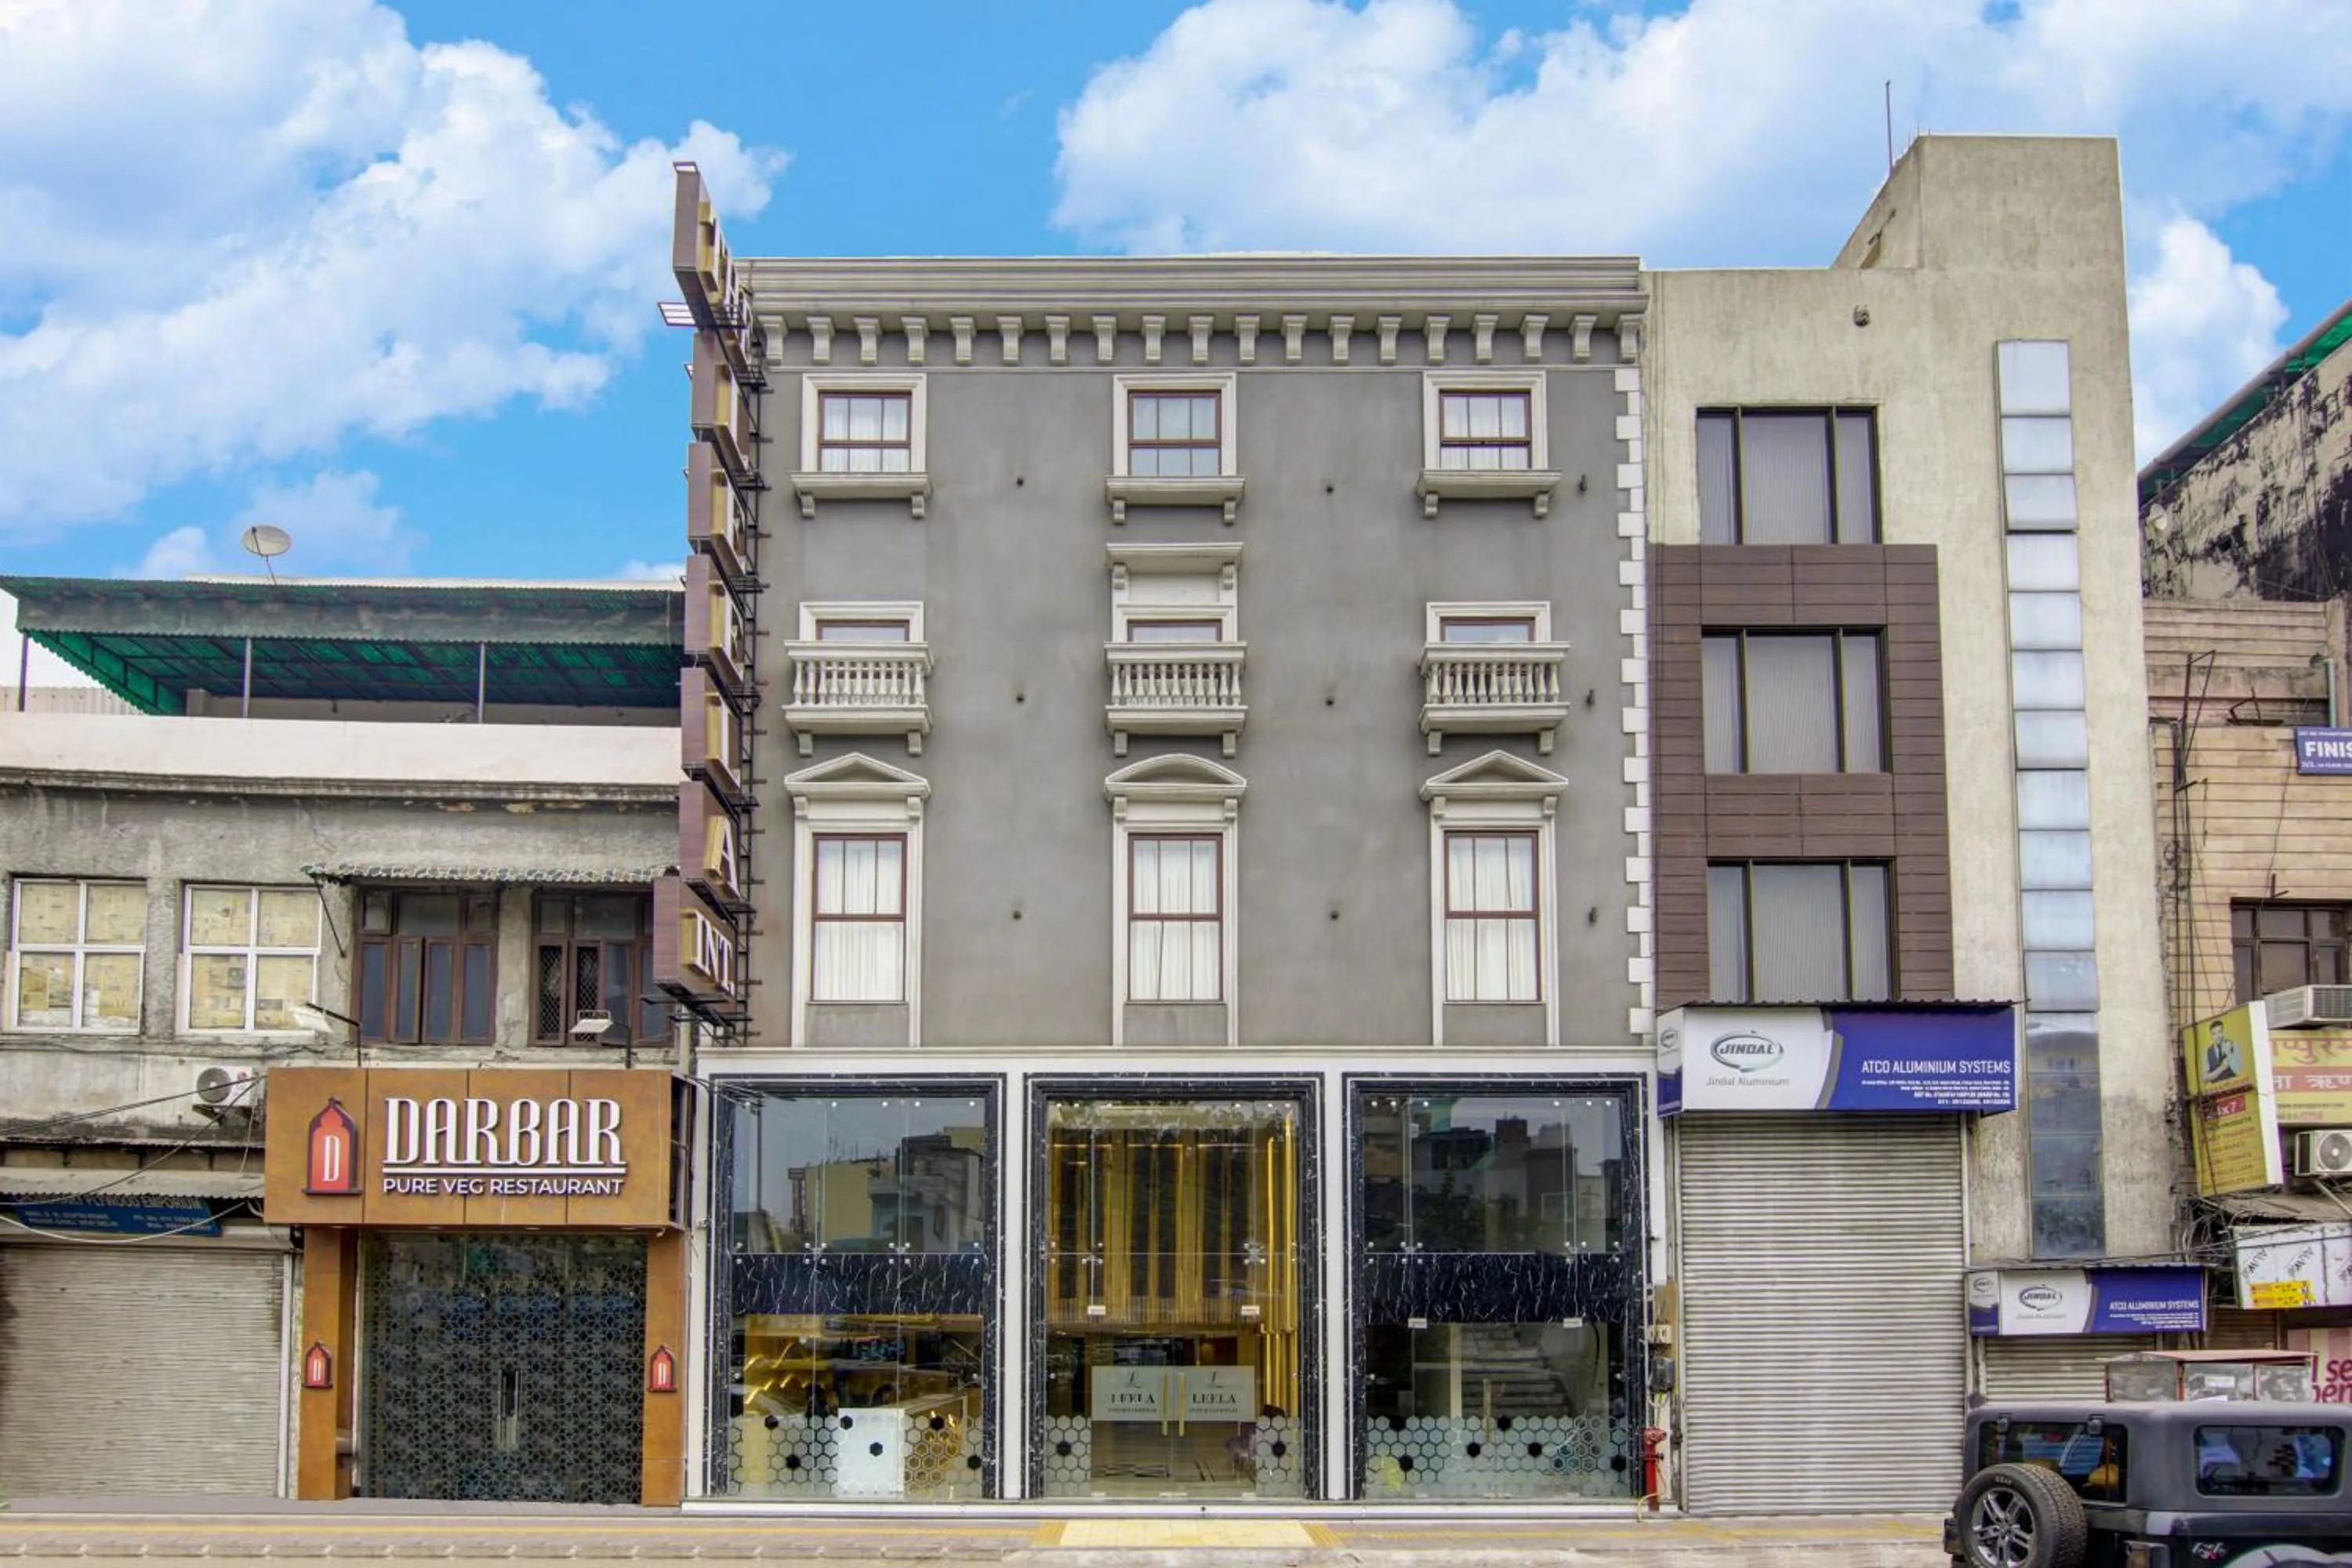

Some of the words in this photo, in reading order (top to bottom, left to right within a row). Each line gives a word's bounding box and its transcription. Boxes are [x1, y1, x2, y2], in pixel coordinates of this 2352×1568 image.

[1719, 1044, 1775, 1054] JINDAL
[1862, 1060, 1890, 1074] ATCO
[1892, 1060, 1956, 1074] ALUMINIUM
[1959, 1060, 2011, 1074] SYSTEMS
[1706, 1076, 1735, 1087] Jindal
[1737, 1076, 1790, 1087] Aluminium
[383, 1098, 627, 1167] DARBAR
[383, 1178, 438, 1194] PURE
[443, 1178, 484, 1194] VEG
[489, 1178, 624, 1195] RESTAURANT
[2167, 1300, 2199, 1309] SYSTEMS
